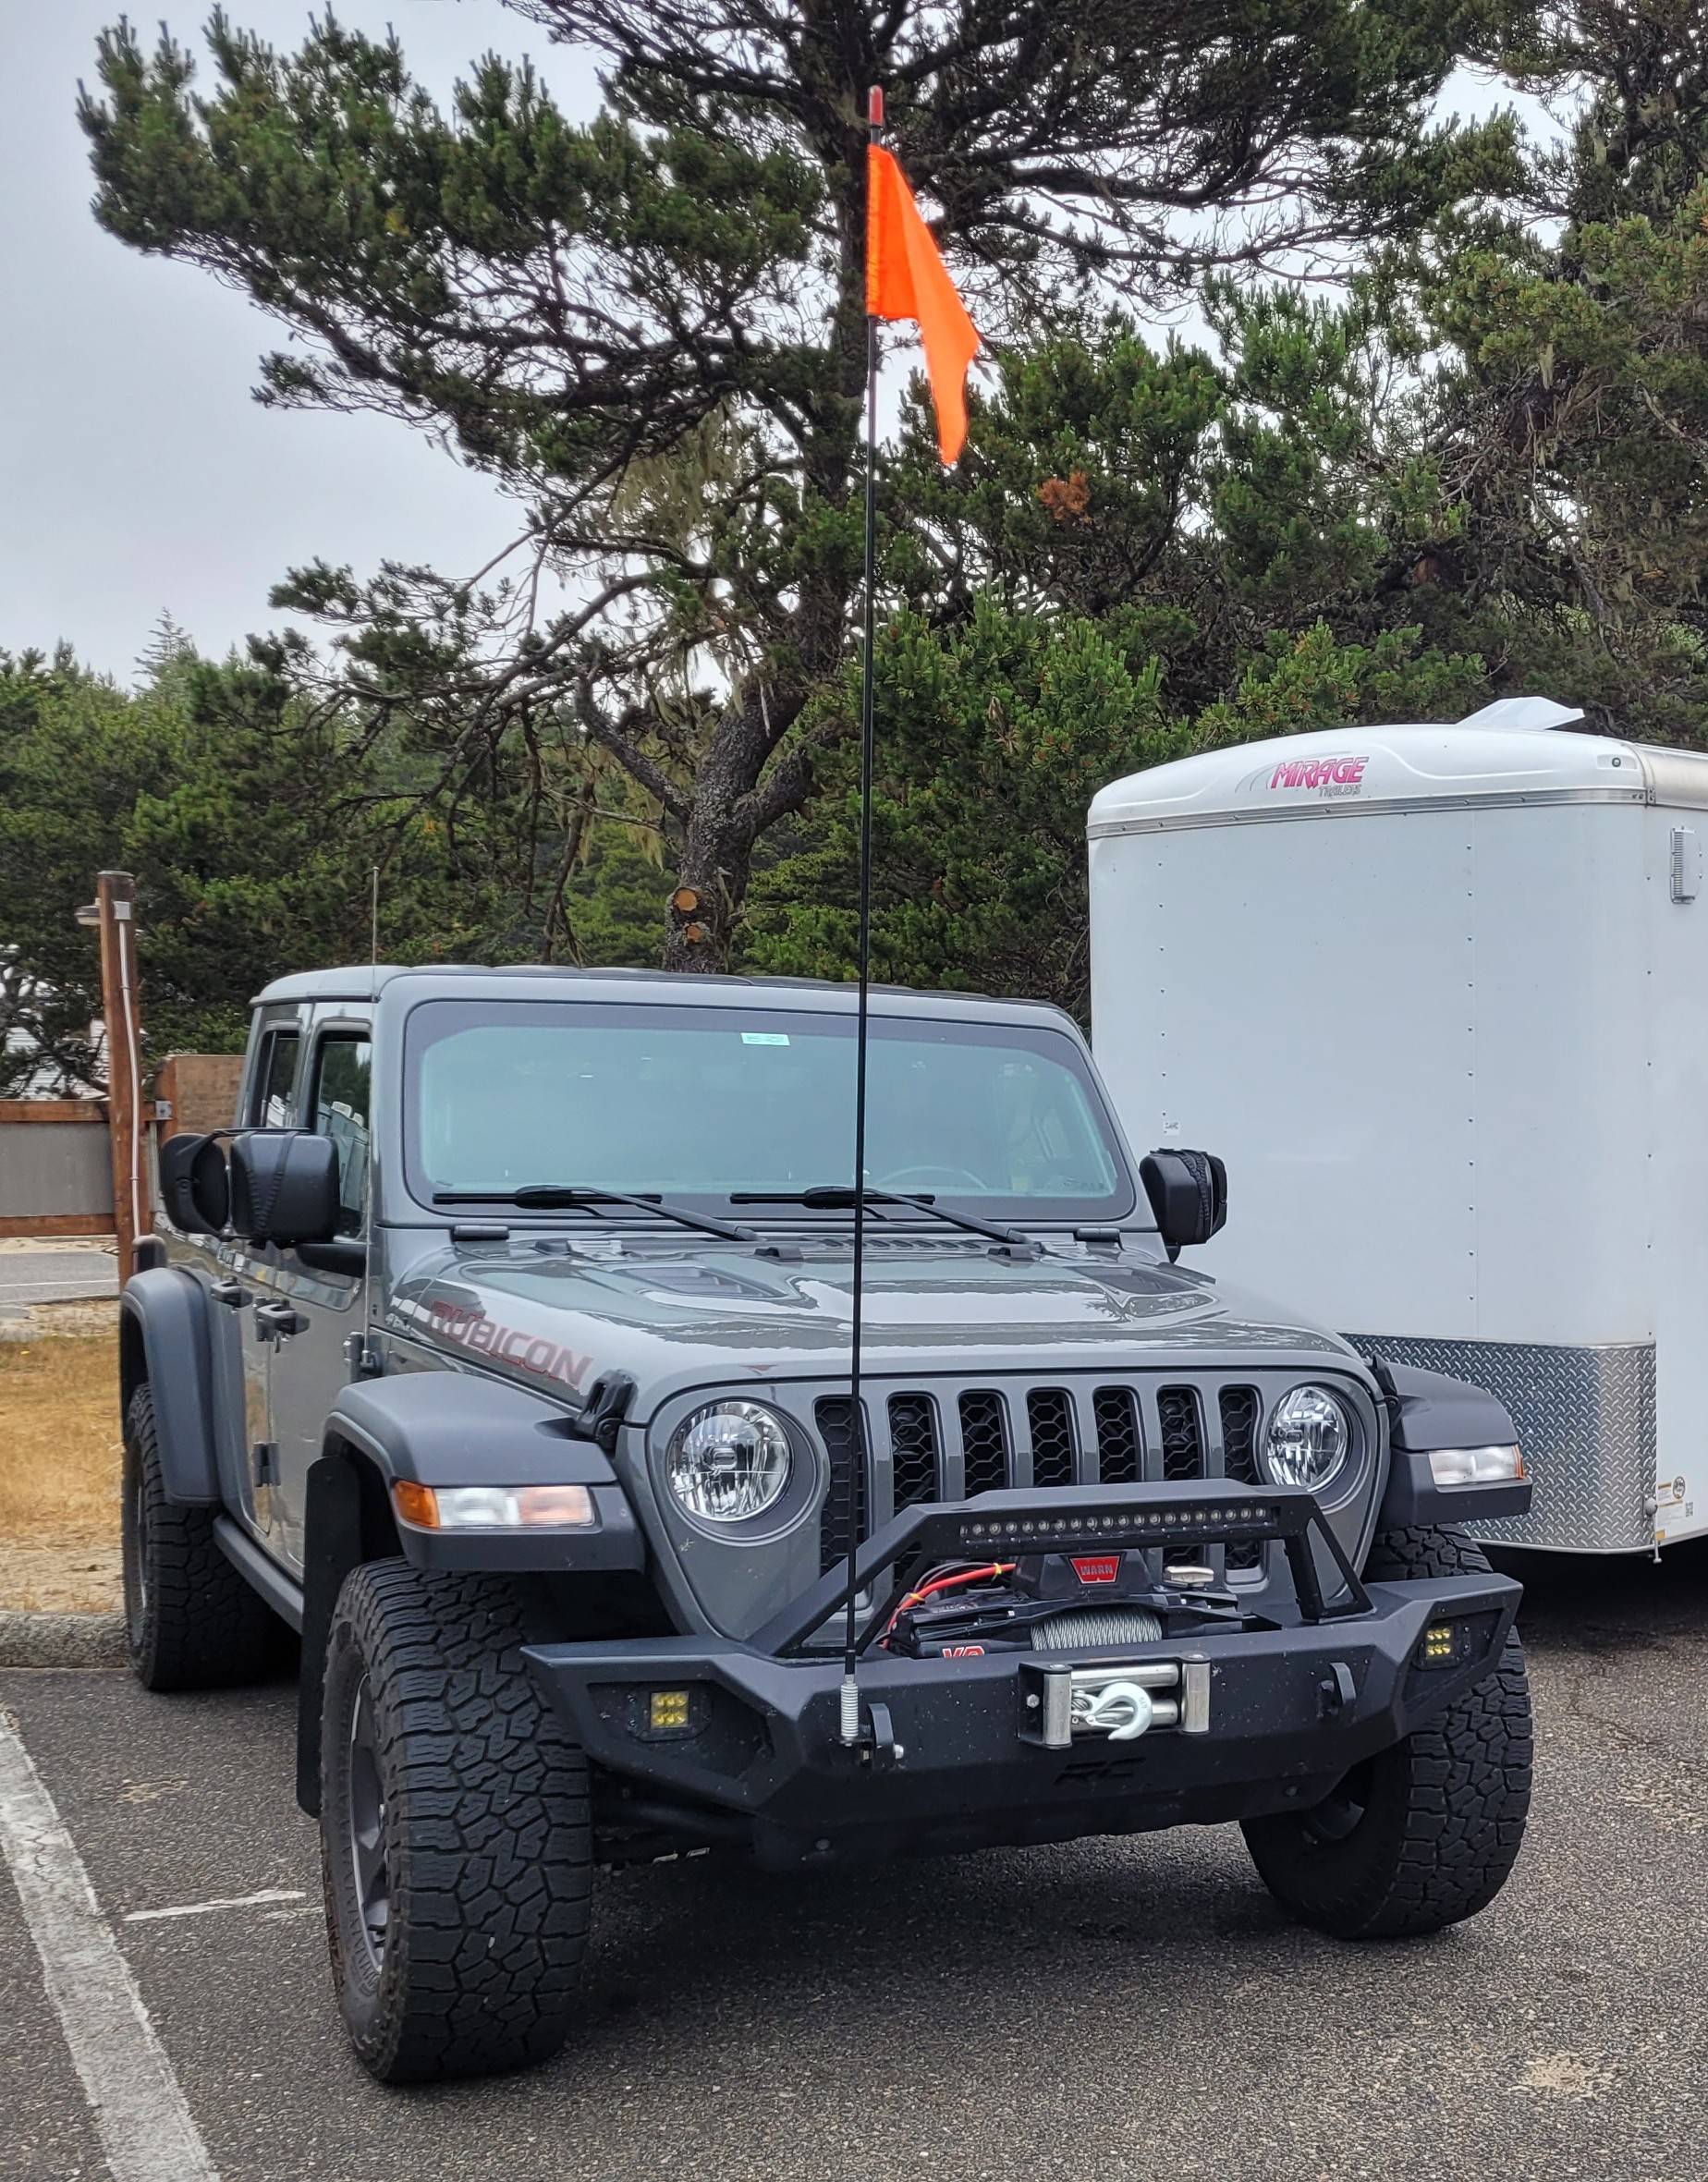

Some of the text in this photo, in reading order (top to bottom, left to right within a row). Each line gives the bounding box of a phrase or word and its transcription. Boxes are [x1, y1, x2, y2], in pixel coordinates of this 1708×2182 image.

[1271, 756, 1370, 789] MIRAGE
[429, 1300, 594, 1387] RUBICON
[1080, 1564, 1114, 1576] WARN
